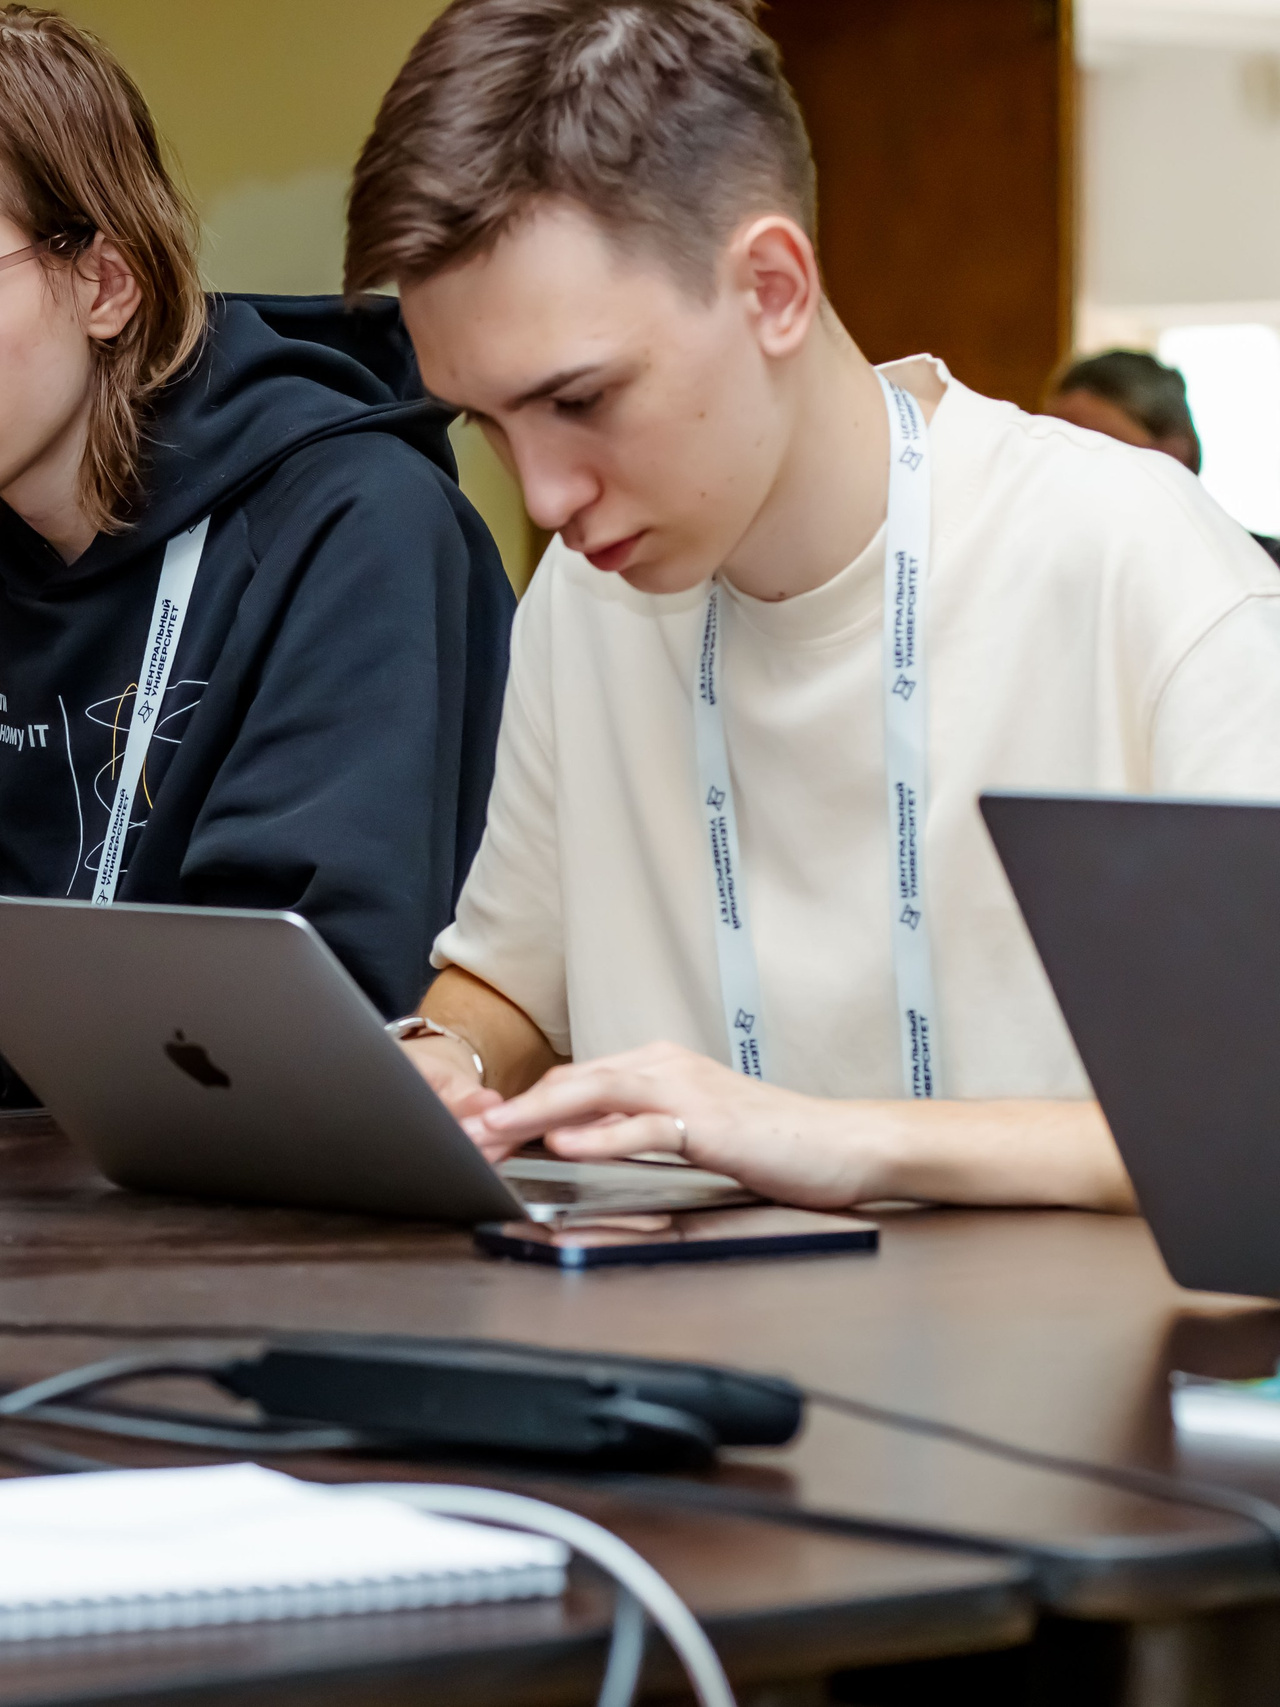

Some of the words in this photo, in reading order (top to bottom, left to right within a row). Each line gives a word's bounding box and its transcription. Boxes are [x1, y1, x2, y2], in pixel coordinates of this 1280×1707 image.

[144, 599, 172, 696] ЦЕНТРАЛЬНЫЙ
[151, 605, 179, 696] УНИВЕРСИТЕТ
[27, 724, 49, 748] IT
[101, 788, 126, 885] ЦЕНТРАЛЬНЫЙ
[106, 794, 129, 886] УНИВЕРСИТЕТ
